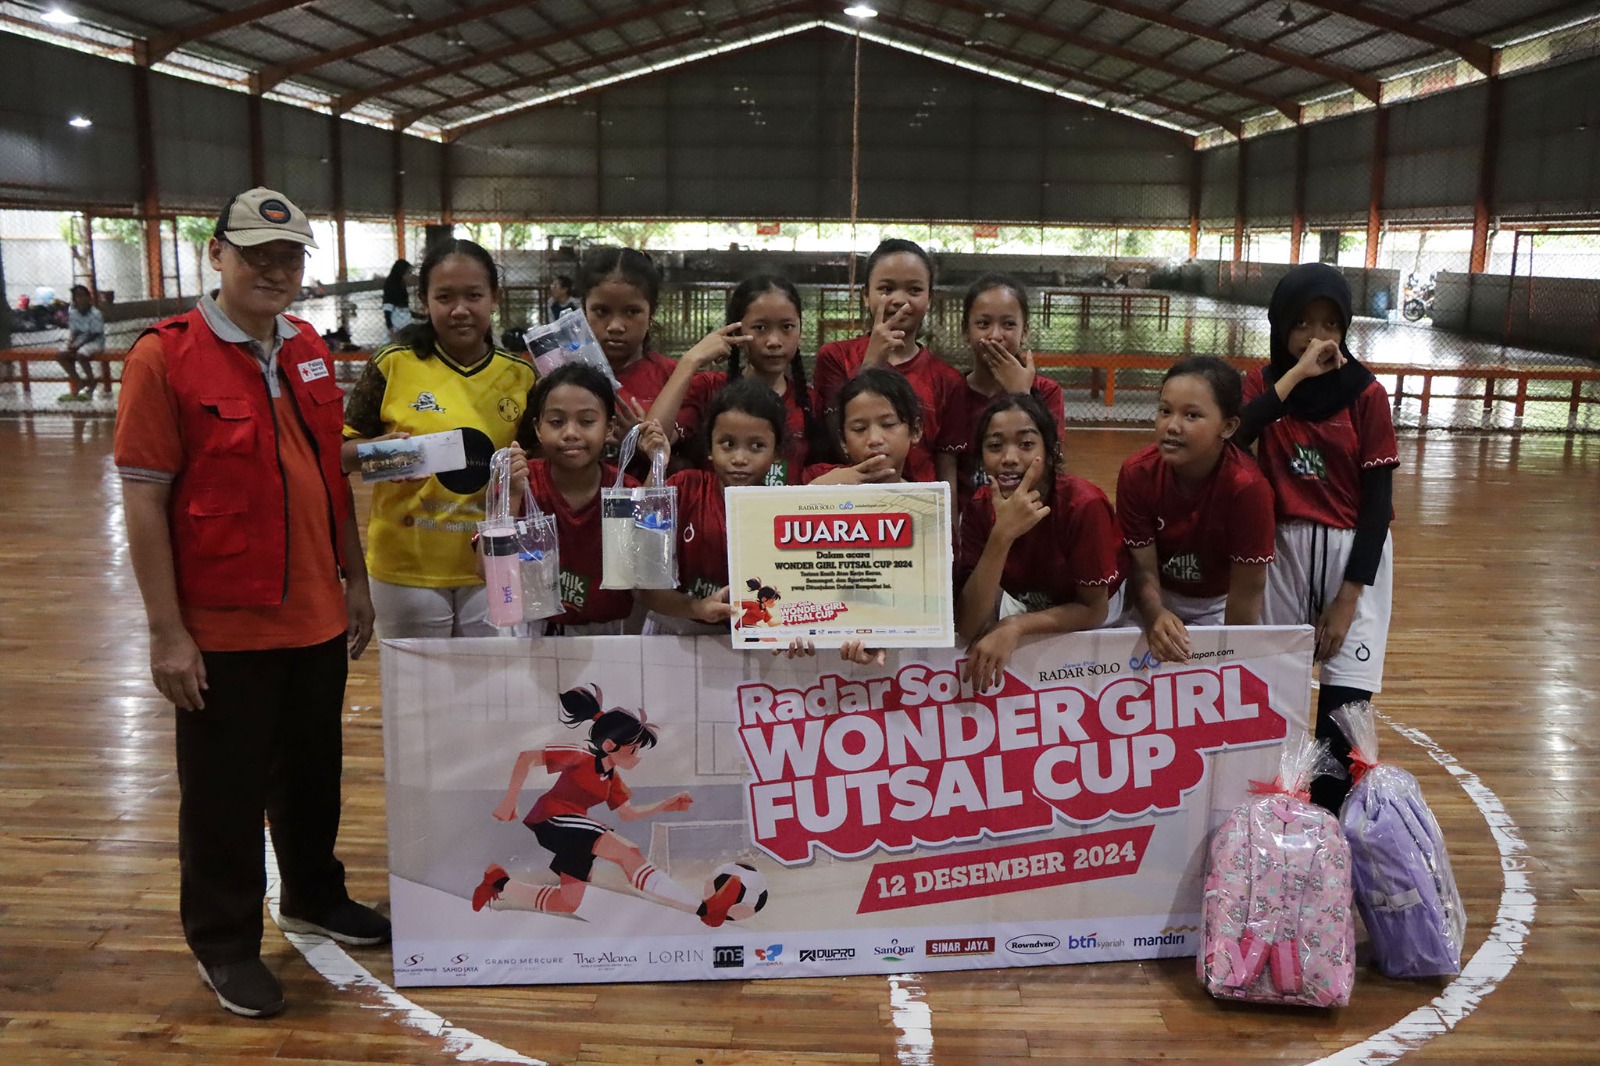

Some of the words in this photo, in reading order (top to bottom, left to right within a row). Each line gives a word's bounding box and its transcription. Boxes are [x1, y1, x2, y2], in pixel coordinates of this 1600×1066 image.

[767, 463, 784, 477] lk
[765, 475, 784, 486] ife
[780, 520, 869, 543] JUARA
[878, 519, 905, 541] IV
[816, 551, 844, 559] Dalam
[1168, 554, 1198, 569] Milk
[775, 562, 814, 570] WONDER
[839, 561, 872, 569] FUTSAL
[893, 560, 913, 568] 2024
[1173, 567, 1201, 580] Life
[694, 577, 721, 597] Mil
[561, 587, 584, 607] ife
[780, 605, 822, 616] WONDER
[823, 602, 845, 611] GIRL
[781, 612, 814, 622] FUTSAL
[815, 610, 834, 619] CUP
[1187, 648, 1234, 660] lapan.com
[1039, 668, 1085, 682] RADAR
[1088, 662, 1120, 677] SOLO
[740, 676, 890, 725] Radar
[748, 689, 1086, 780] WONDER
[1099, 668, 1260, 736] GIRL
[752, 754, 1023, 840] FUTSAL
[1033, 734, 1177, 800] CUP
[877, 875, 907, 899] 12
[913, 850, 1066, 894] DESEMBER
[1073, 840, 1137, 868] 2024
[931, 942, 961, 953] SINAR
[964, 940, 989, 951] JAYA
[1134, 933, 1185, 947] mandiri
[573, 952, 596, 964] The
[597, 951, 637, 963] Alana
[648, 950, 704, 964] LORIN
